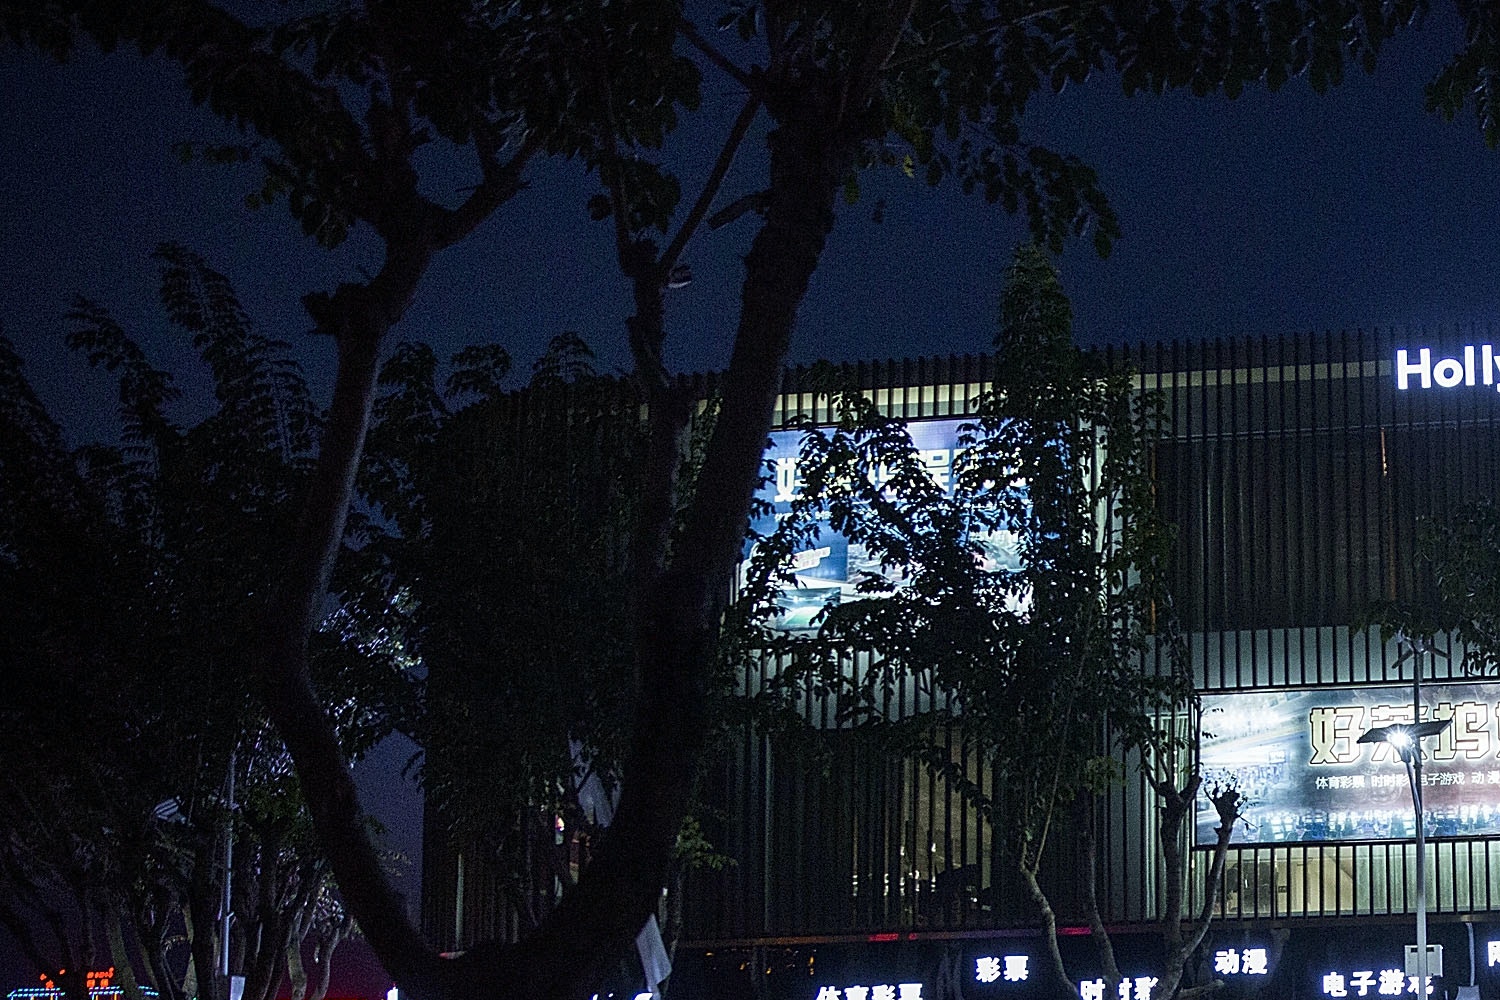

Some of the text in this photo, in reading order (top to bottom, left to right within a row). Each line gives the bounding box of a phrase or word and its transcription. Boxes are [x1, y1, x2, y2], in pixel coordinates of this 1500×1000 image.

[1315, 774, 1366, 789] 体育彩票
[1214, 948, 1267, 975] 动漫
